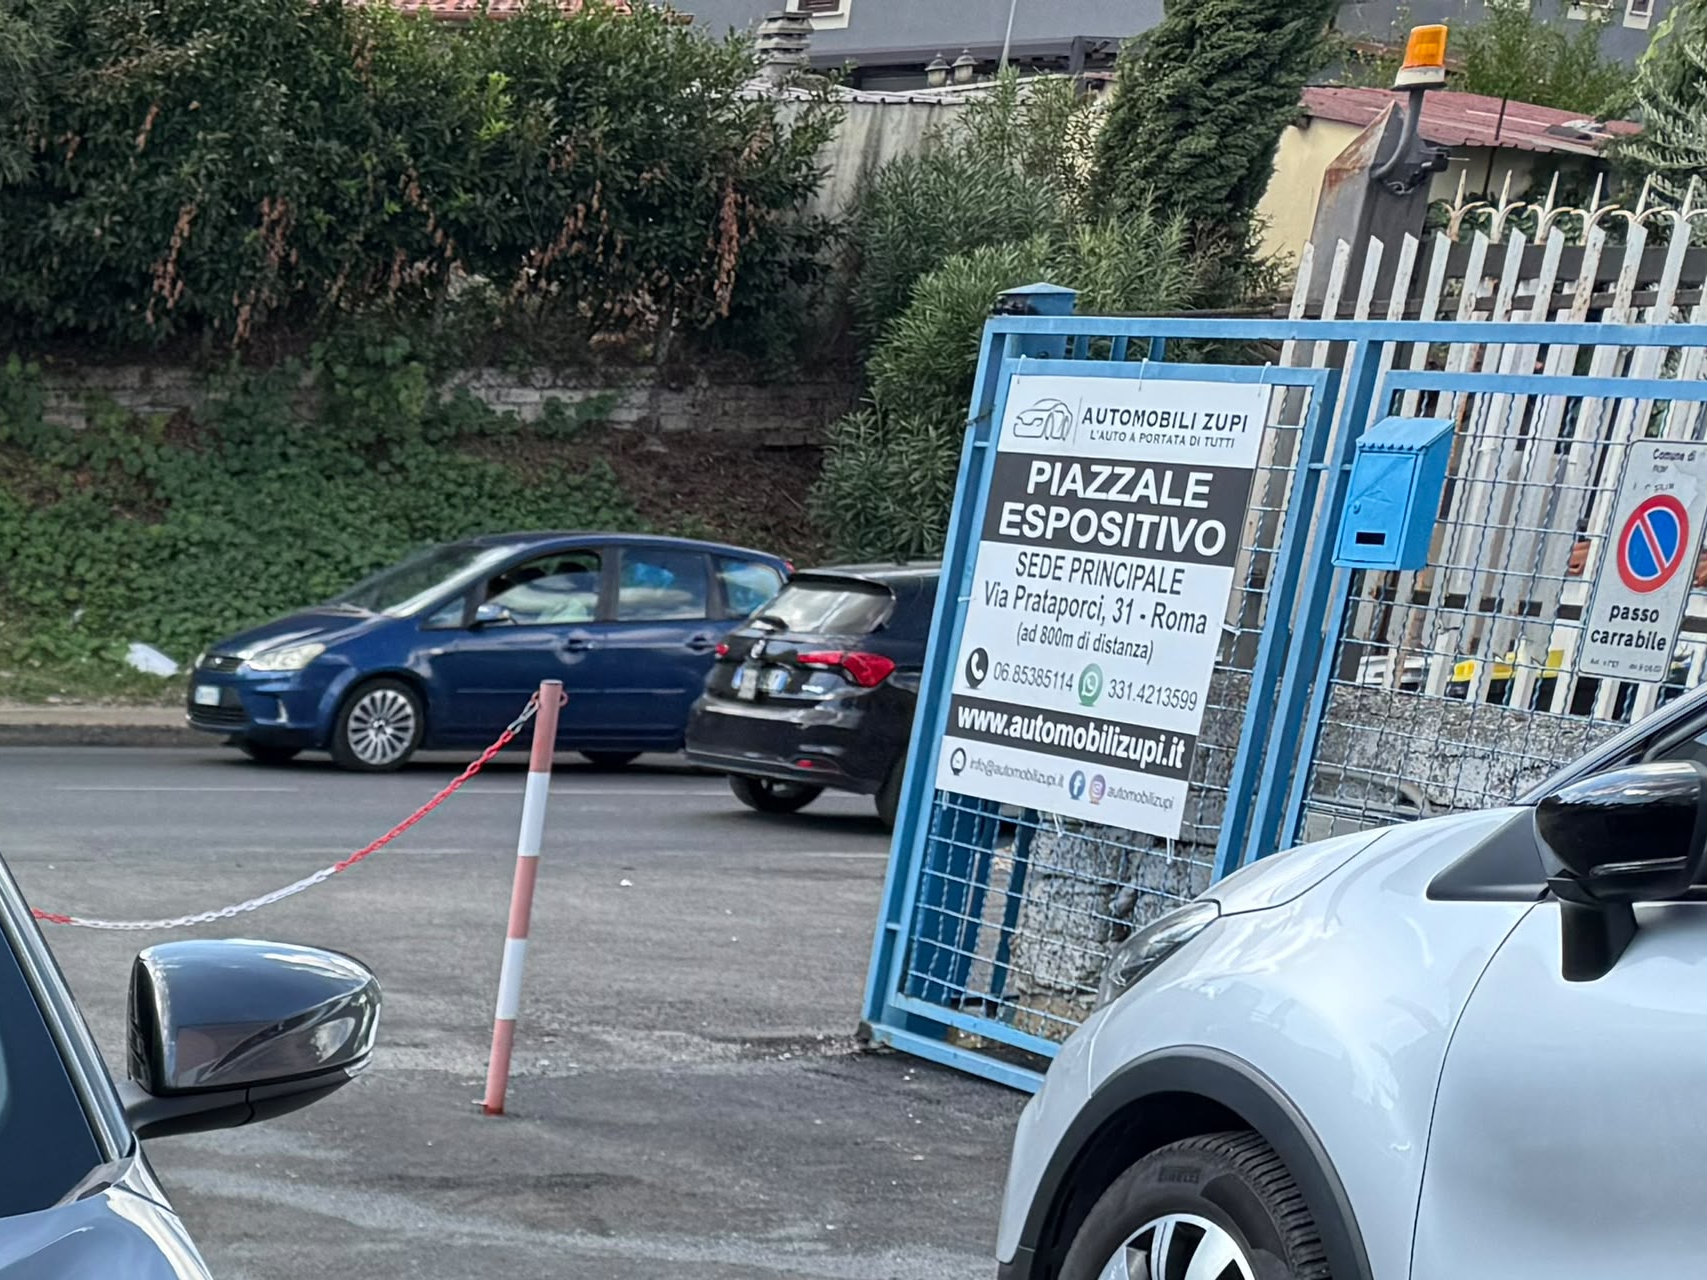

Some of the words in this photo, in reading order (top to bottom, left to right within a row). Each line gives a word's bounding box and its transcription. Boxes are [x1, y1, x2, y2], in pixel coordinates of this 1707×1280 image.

[1081, 407, 1196, 430] AUTOMOBILI
[1202, 413, 1248, 433] ZUPI
[1090, 429, 1126, 442] L'AUTO
[1128, 433, 1136, 442] A
[1139, 433, 1186, 446] PORTATA
[1189, 436, 1200, 447] DI
[1204, 437, 1235, 448] TUTTI
[1653, 447, 1685, 461] Comune
[1687, 450, 1697, 462] di
[1027, 460, 1213, 508] PIAZZALE
[998, 501, 1226, 556] ESPOSITIVO
[1015, 551, 1066, 581] SEDE
[1068, 556, 1185, 596] PRINCIPALE
[984, 580, 1008, 608] Via
[1013, 585, 1106, 626] Prataporci,
[1112, 597, 1134, 625] 31
[1150, 602, 1207, 635] Roma
[1609, 604, 1660, 623] passo
[1016, 622, 1037, 646] (ad
[1040, 625, 1073, 649] 800m
[1077, 631, 1090, 650] di
[1093, 634, 1154, 665] distanza)
[1590, 628, 1667, 652] carrabile
[993, 661, 1074, 692] 06.85385114
[1107, 679, 1198, 711] 331.4213599
[958, 705, 1186, 769] www.automobilizupi.it
[1107, 785, 1175, 810] automobilizupi
